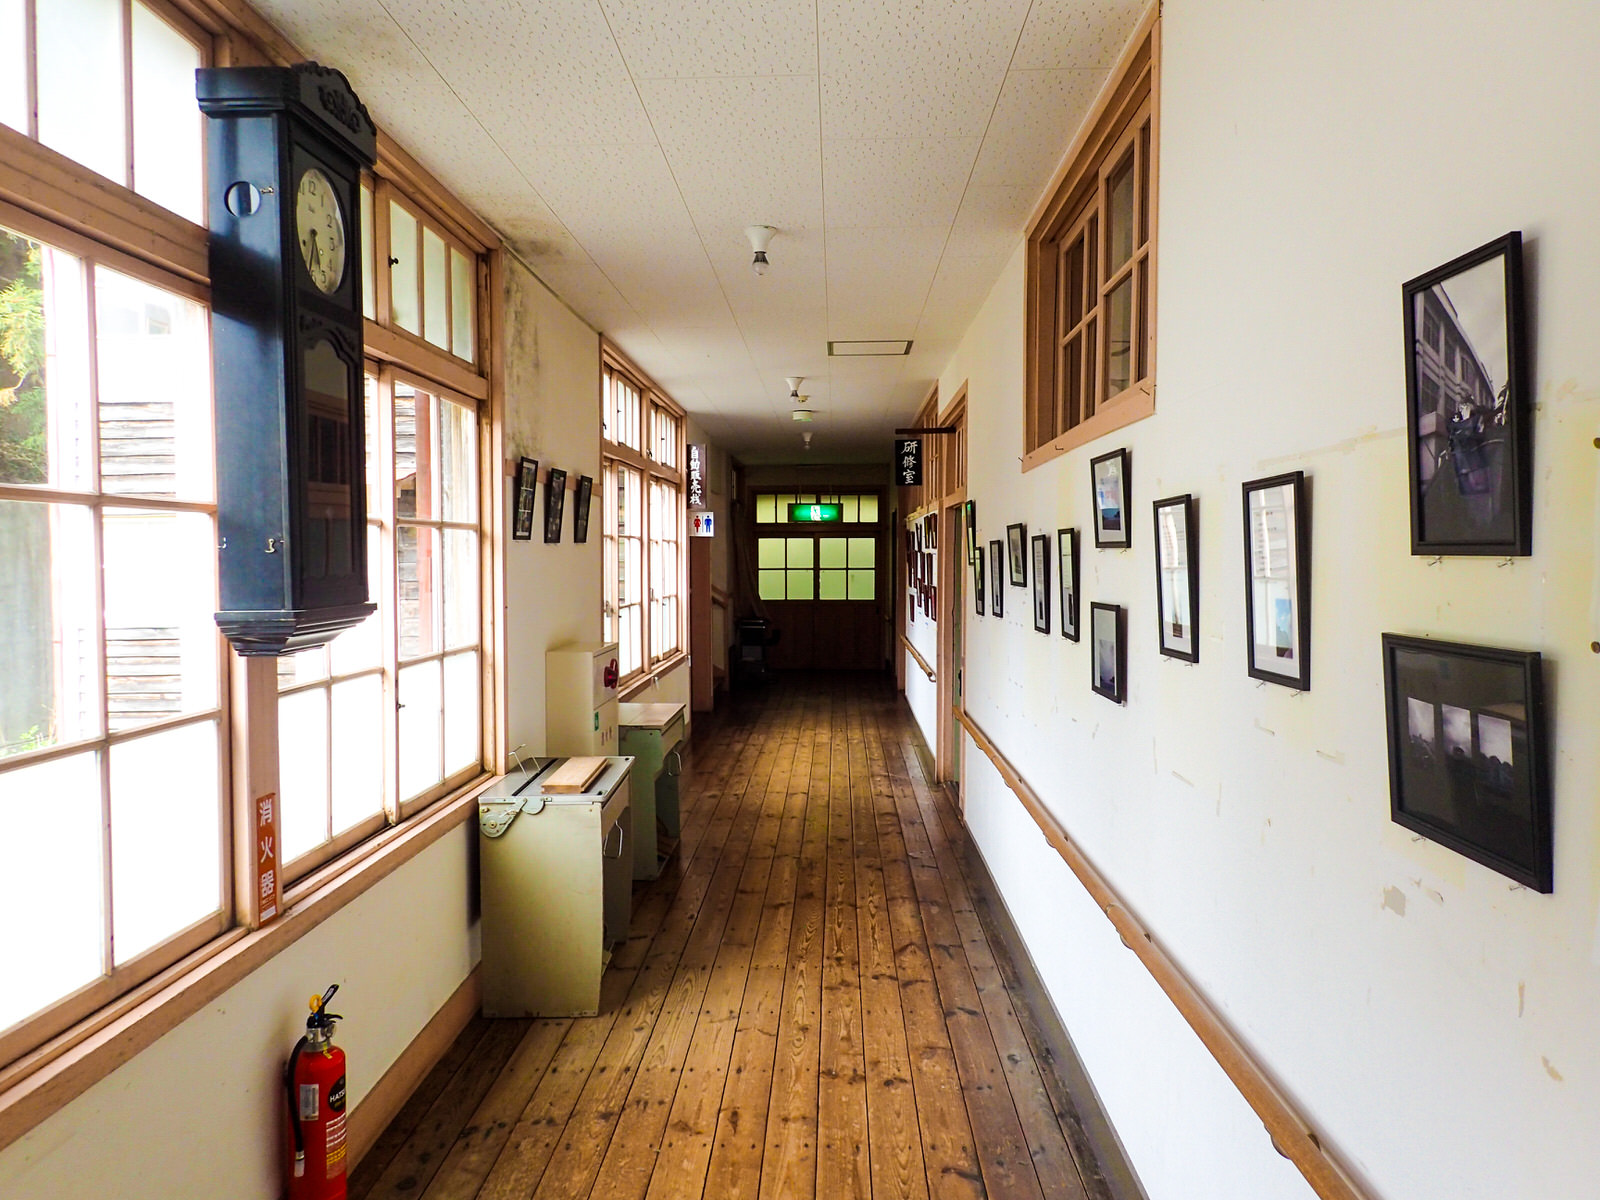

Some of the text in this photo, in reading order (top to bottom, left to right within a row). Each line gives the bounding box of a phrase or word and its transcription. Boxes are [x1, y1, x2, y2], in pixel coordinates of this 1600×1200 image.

[326, 214, 333, 229] 2
[329, 236, 336, 252] 3
[900, 440, 918, 485] 研修室
[259, 798, 275, 898] 消火器
